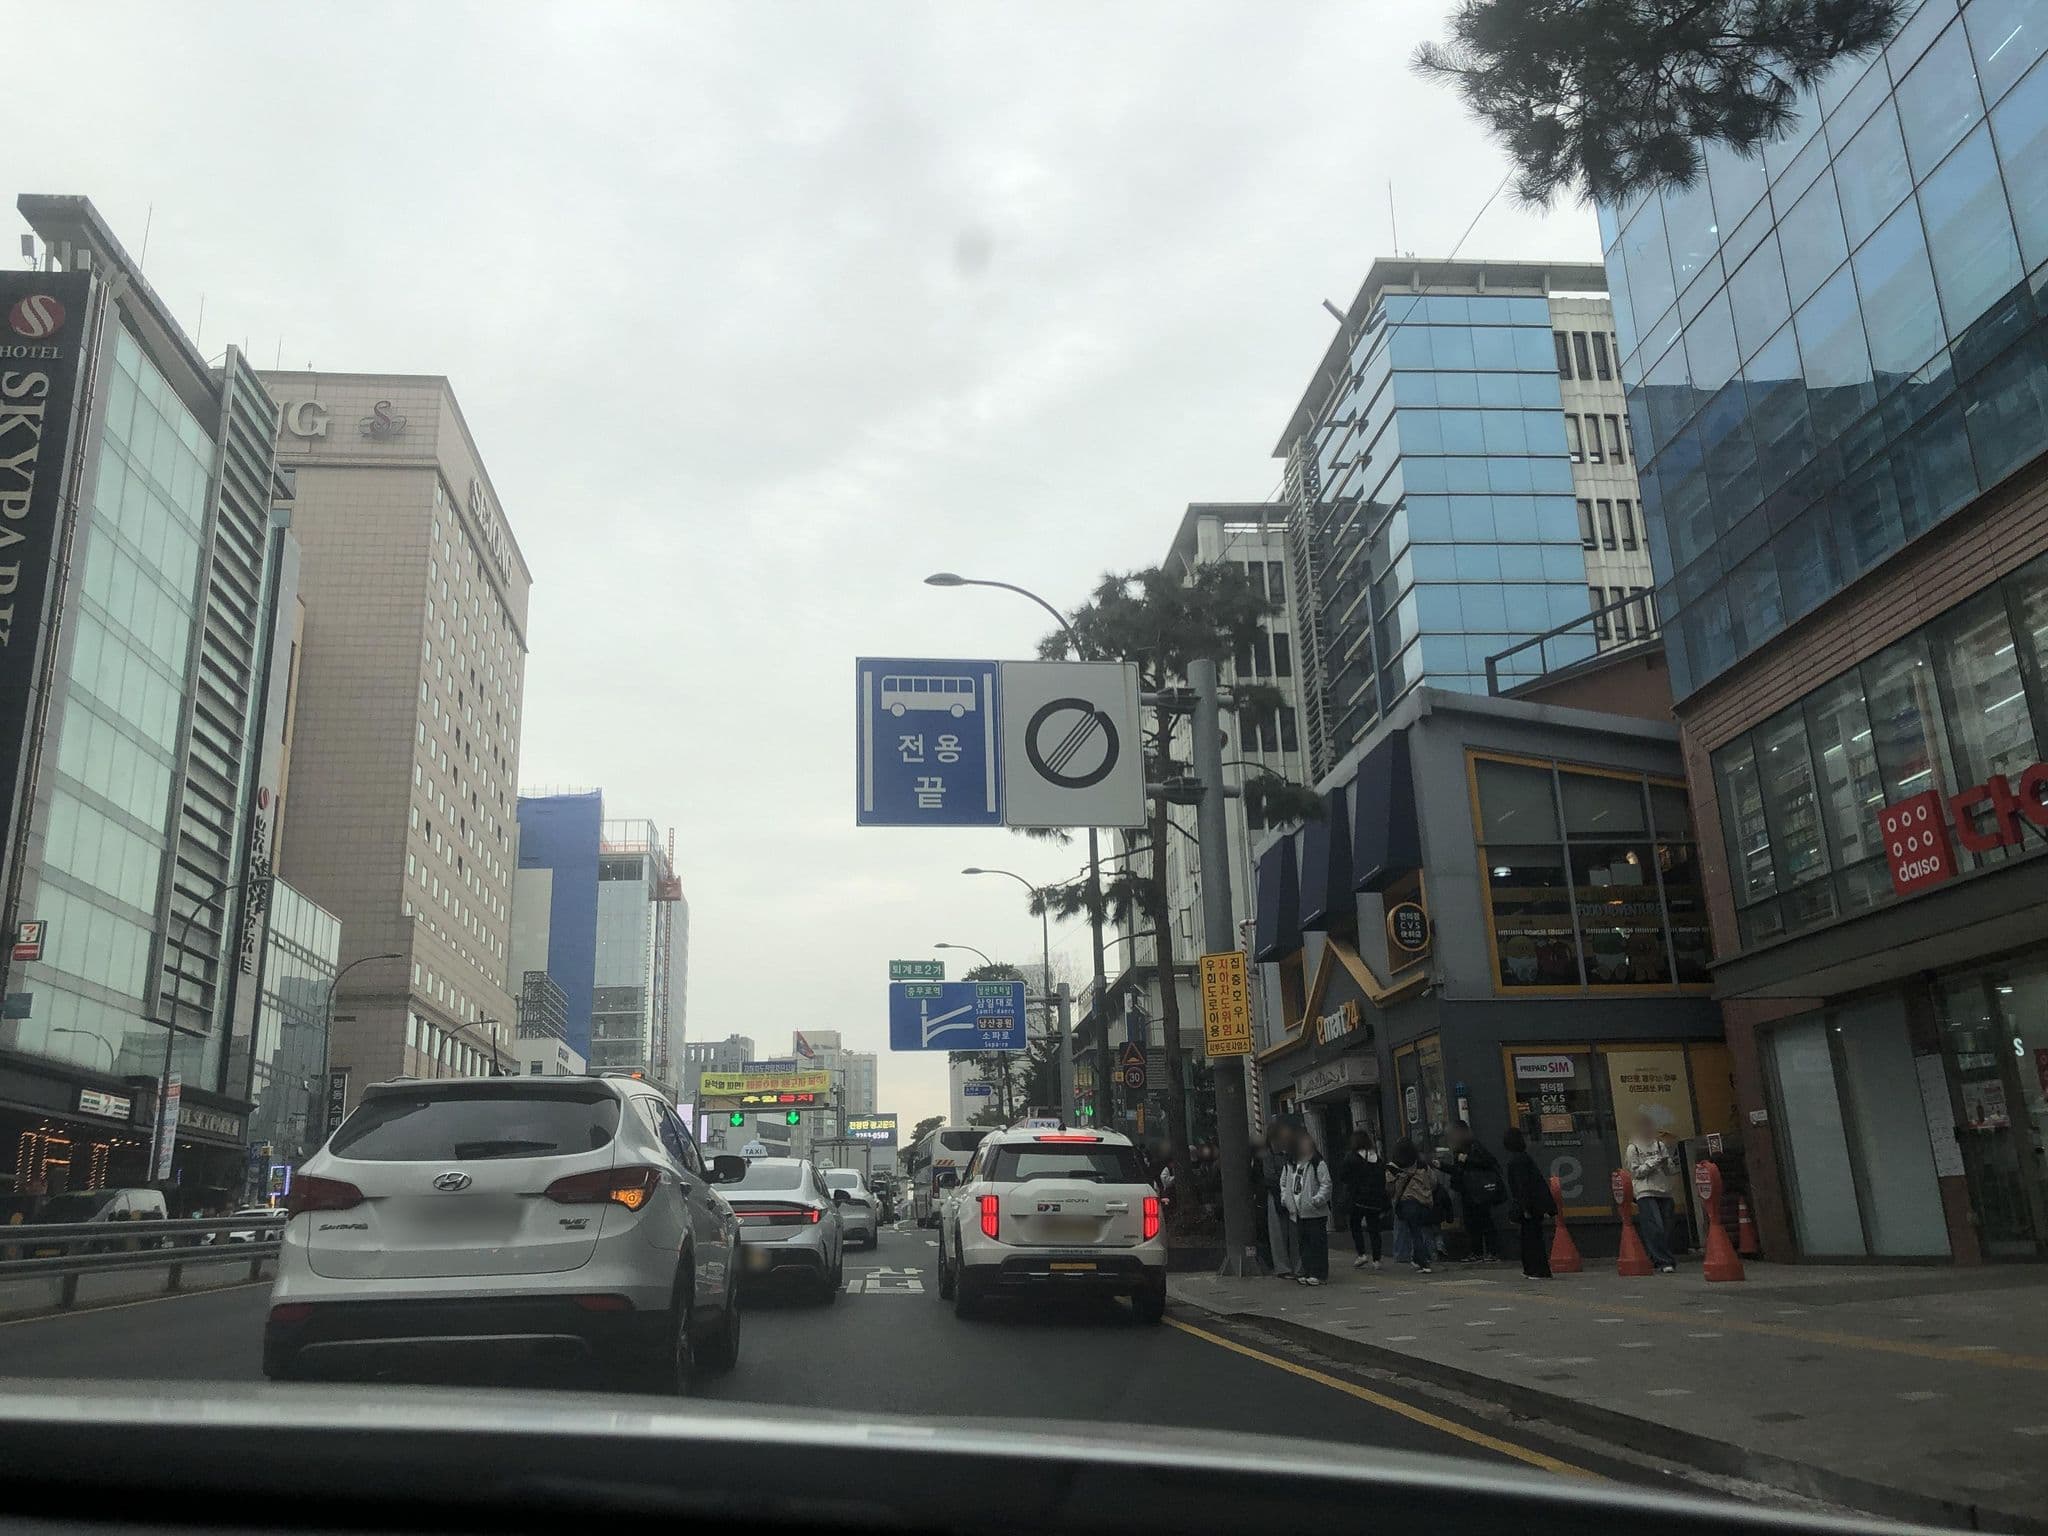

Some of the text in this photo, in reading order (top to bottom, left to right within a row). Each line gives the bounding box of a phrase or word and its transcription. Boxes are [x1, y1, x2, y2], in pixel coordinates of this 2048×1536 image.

[0, 345, 65, 361] HOTEL
[898, 733, 963, 763] 전용
[914, 776, 947, 809] 끝
[1898, 855, 1940, 882] daiso
[1399, 912, 1420, 921] 편의점
[892, 965, 942, 975] 퇴계로2가
[907, 986, 942, 996] 충무로역
[1230, 957, 1245, 1036] 집중호우시
[976, 998, 1014, 1008] 삼일대로
[1206, 959, 1219, 1037] 우회도로이용
[979, 1018, 1012, 1029] 남산공원
[1316, 998, 1360, 1046] emart24
[982, 1031, 1011, 1040] 소파로
[1520, 1062, 1569, 1073] PREPAID SIM
[1129, 1072, 1140, 1082] 30
[1540, 1082, 1564, 1093] 편의점
[329, 1078, 344, 1133] 명동스테
[1033, 1121, 1055, 1129] TAXI
